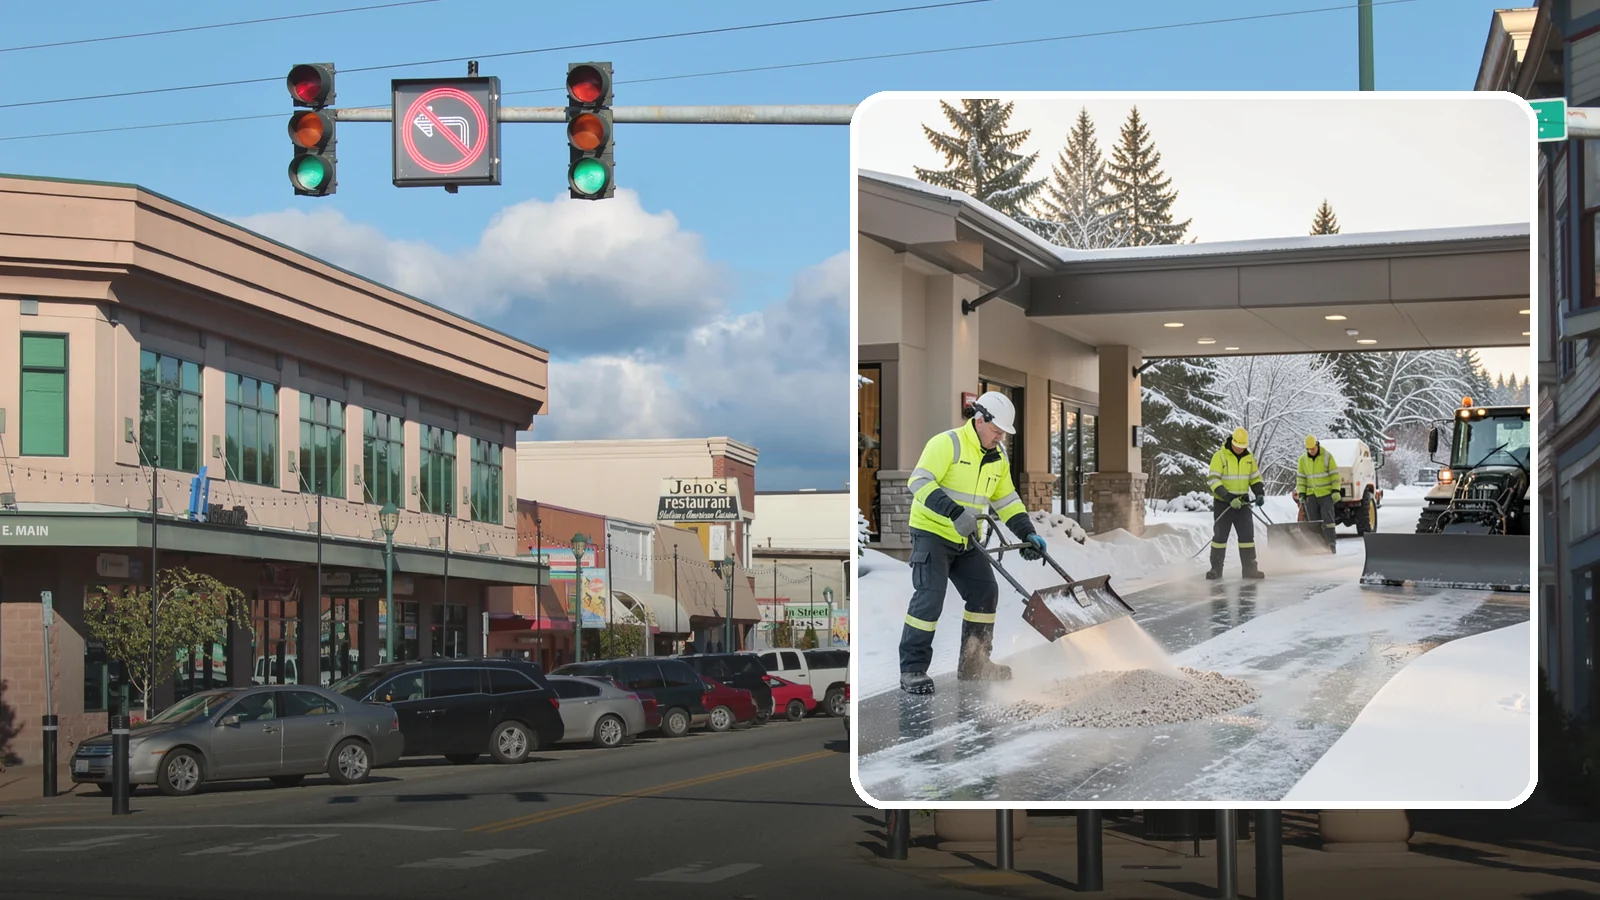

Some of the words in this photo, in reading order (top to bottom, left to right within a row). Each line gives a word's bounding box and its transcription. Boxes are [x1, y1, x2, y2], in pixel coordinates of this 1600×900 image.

[670, 480, 728, 494] Jeno's
[665, 496, 731, 509] restaurant
[659, 510, 681, 520] Italian
[686, 510, 714, 519] American
[715, 509, 737, 519] Cuisine
[2, 525, 13, 536] E.
[15, 525, 49, 536] MAIN
[785, 607, 795, 617] in
[797, 607, 828, 617] Street
[791, 619, 824, 627] lass
